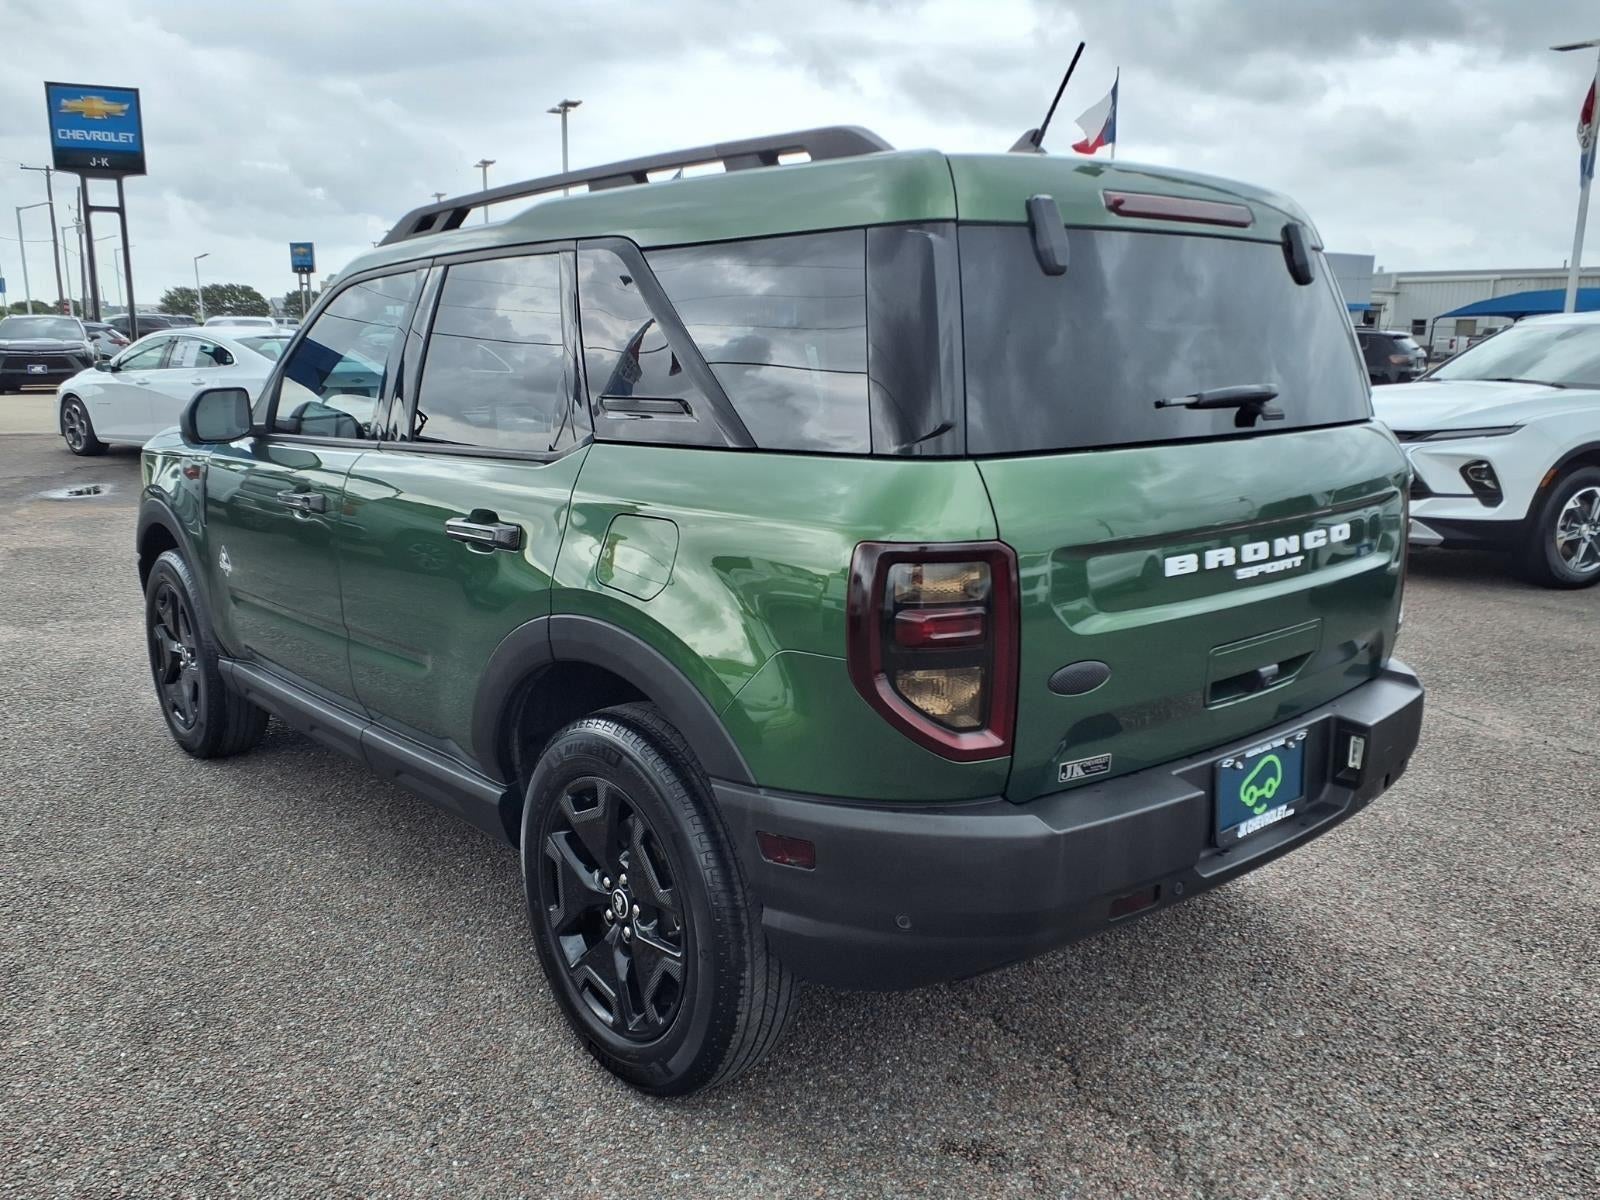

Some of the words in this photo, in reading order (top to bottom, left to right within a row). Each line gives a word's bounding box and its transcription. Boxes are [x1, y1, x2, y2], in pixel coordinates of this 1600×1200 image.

[57, 129, 135, 143] CHEVROLET
[89, 157, 109, 167] J-K
[1164, 522, 1351, 577] BRONCO
[1235, 555, 1305, 580] SPORT
[1061, 764, 1085, 780] JK
